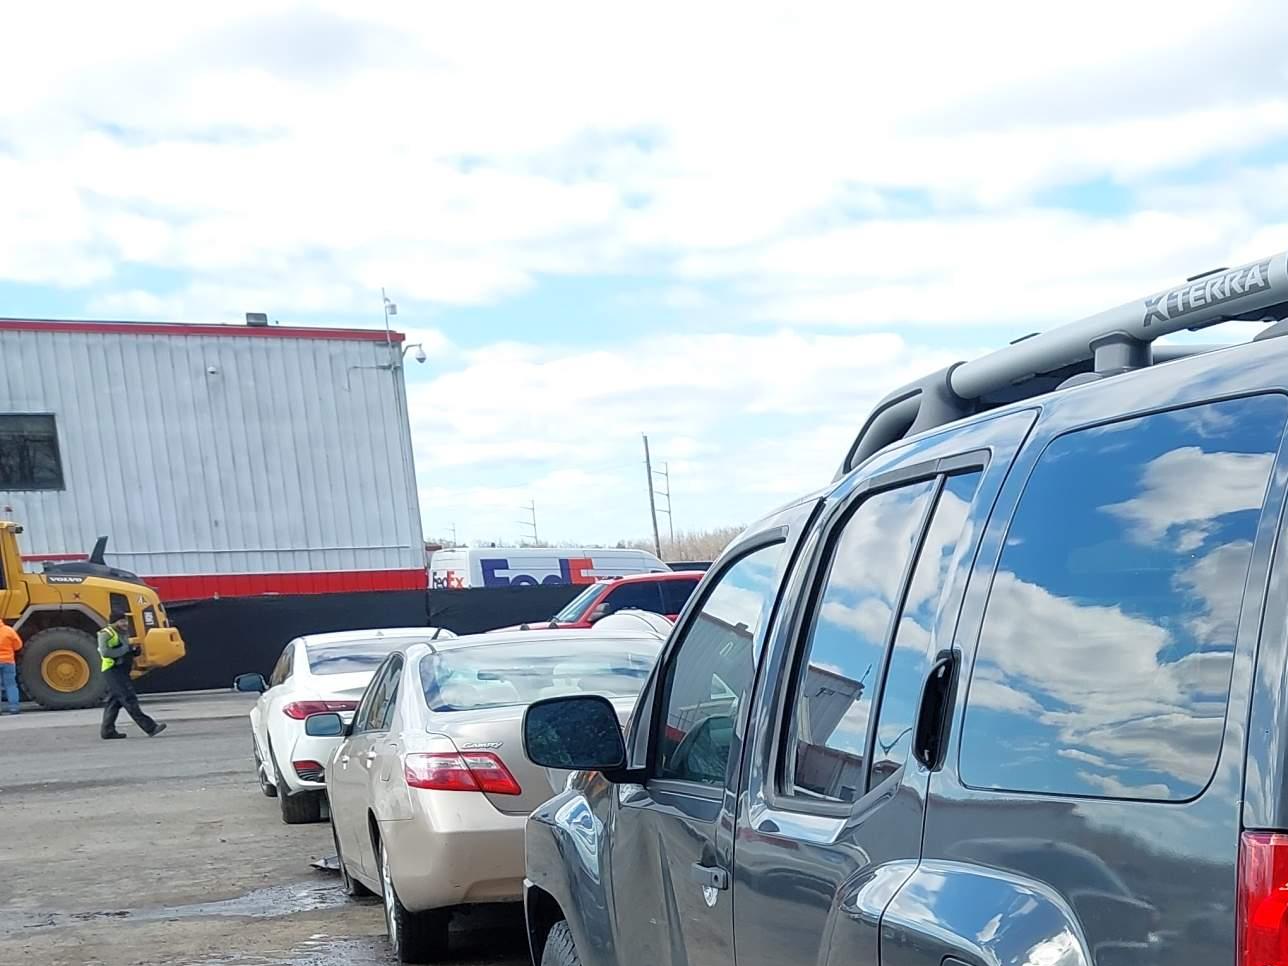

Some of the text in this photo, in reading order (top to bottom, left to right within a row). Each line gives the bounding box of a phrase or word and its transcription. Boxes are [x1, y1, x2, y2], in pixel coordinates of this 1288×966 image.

[1143, 264, 1265, 327] XTERRA
[432, 571, 464, 590] FedEx
[480, 557, 624, 587] FedE
